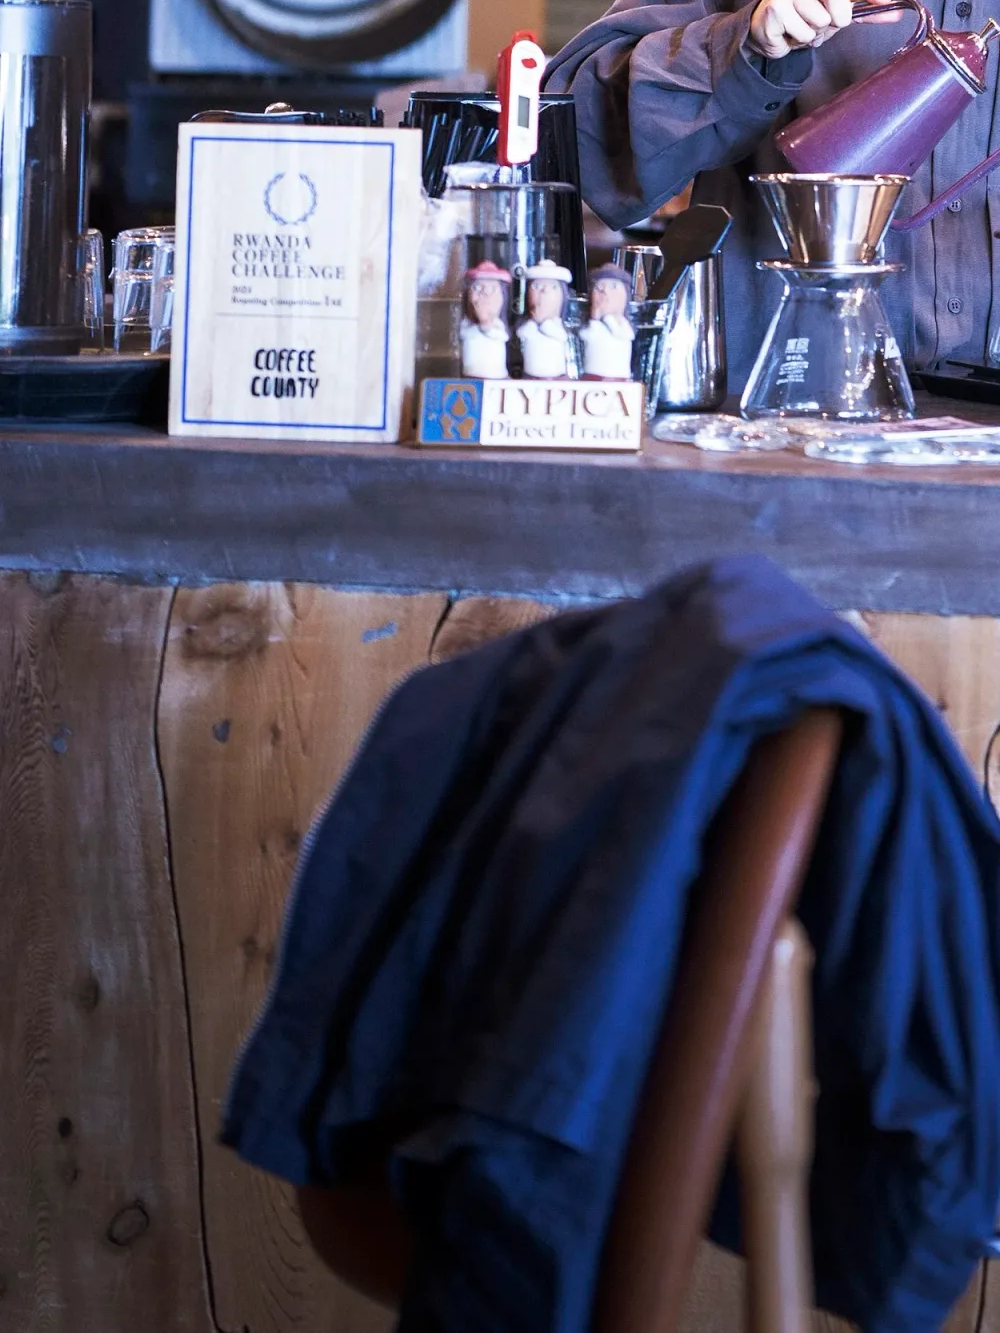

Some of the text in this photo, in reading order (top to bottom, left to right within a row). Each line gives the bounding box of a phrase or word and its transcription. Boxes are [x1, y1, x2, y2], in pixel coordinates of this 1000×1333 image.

[233, 234, 311, 249] RWANDA
[232, 249, 301, 263] COFFEE
[232, 264, 345, 279] CHALLENGE
[255, 348, 316, 372] COFFEE
[251, 376, 319, 399] COUNTY
[489, 387, 631, 417] TYPICA
[489, 420, 635, 441] Direct Trade
